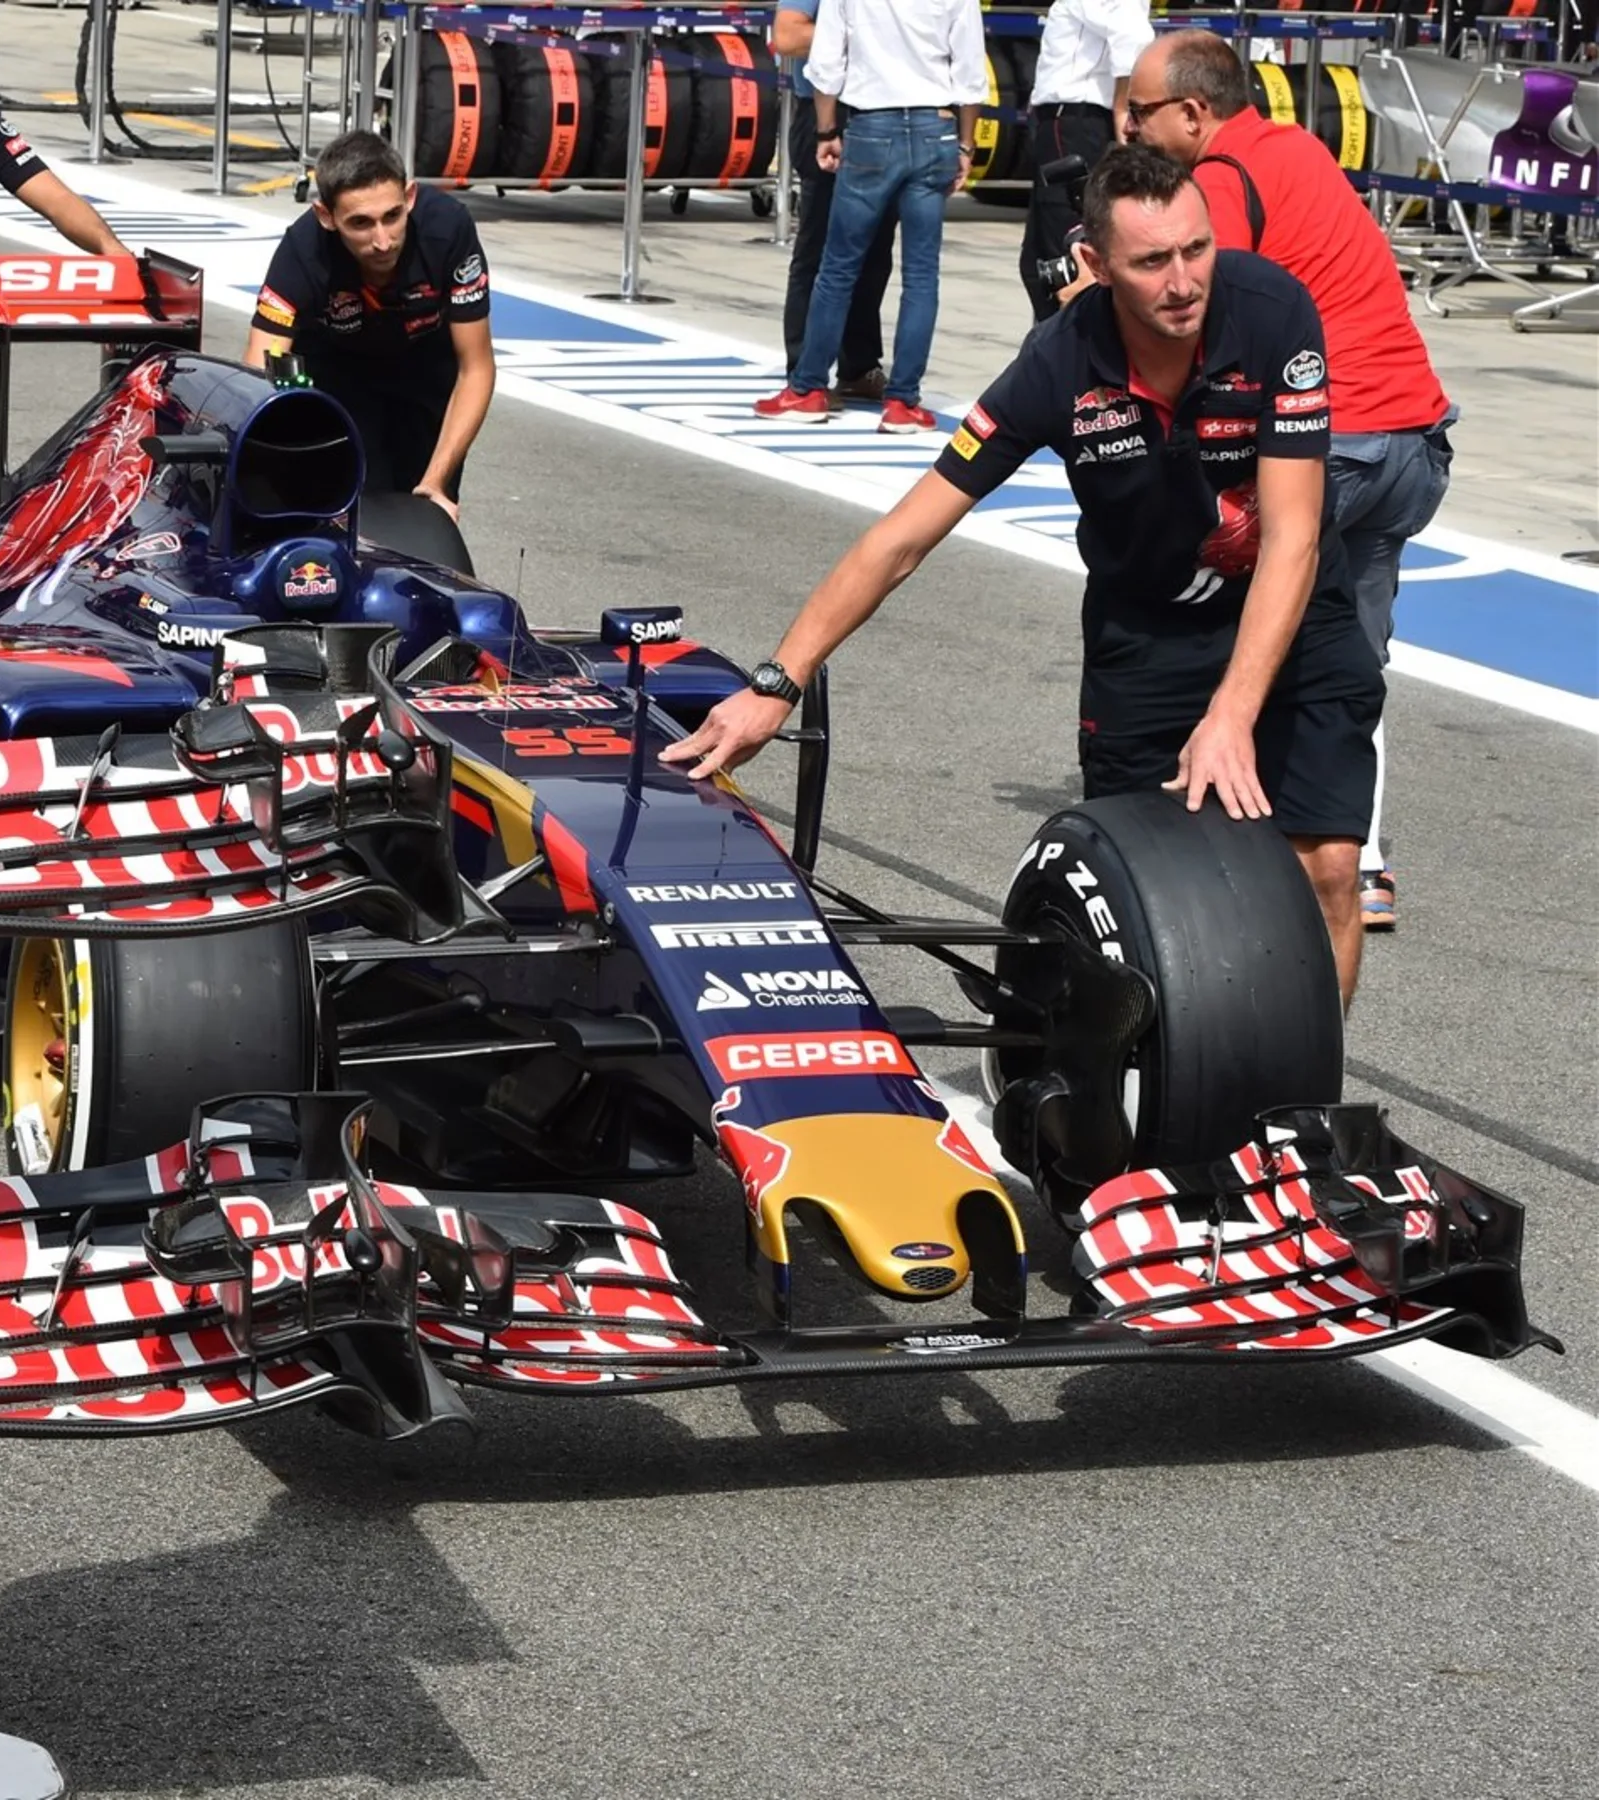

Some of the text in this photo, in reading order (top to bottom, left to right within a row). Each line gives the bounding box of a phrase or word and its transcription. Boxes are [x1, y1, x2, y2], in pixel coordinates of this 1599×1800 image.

[1071, 404, 1142, 437] Red Bull
[1099, 435, 1147, 455] NOVA
[1200, 446, 1257, 461] SAPIND
[285, 580, 311, 597] Red
[157, 620, 227, 647] SAPIN
[630, 618, 683, 644] SAPIN
[501, 728, 637, 757] 55
[626, 881, 799, 903] RENAULT
[1037, 842, 1126, 963] P ZE
[649, 920, 832, 949] PIRELLI
[747, 970, 861, 992] NOVA
[754, 989, 869, 1010] Chemicals
[726, 1039, 899, 1071] CEPSA
